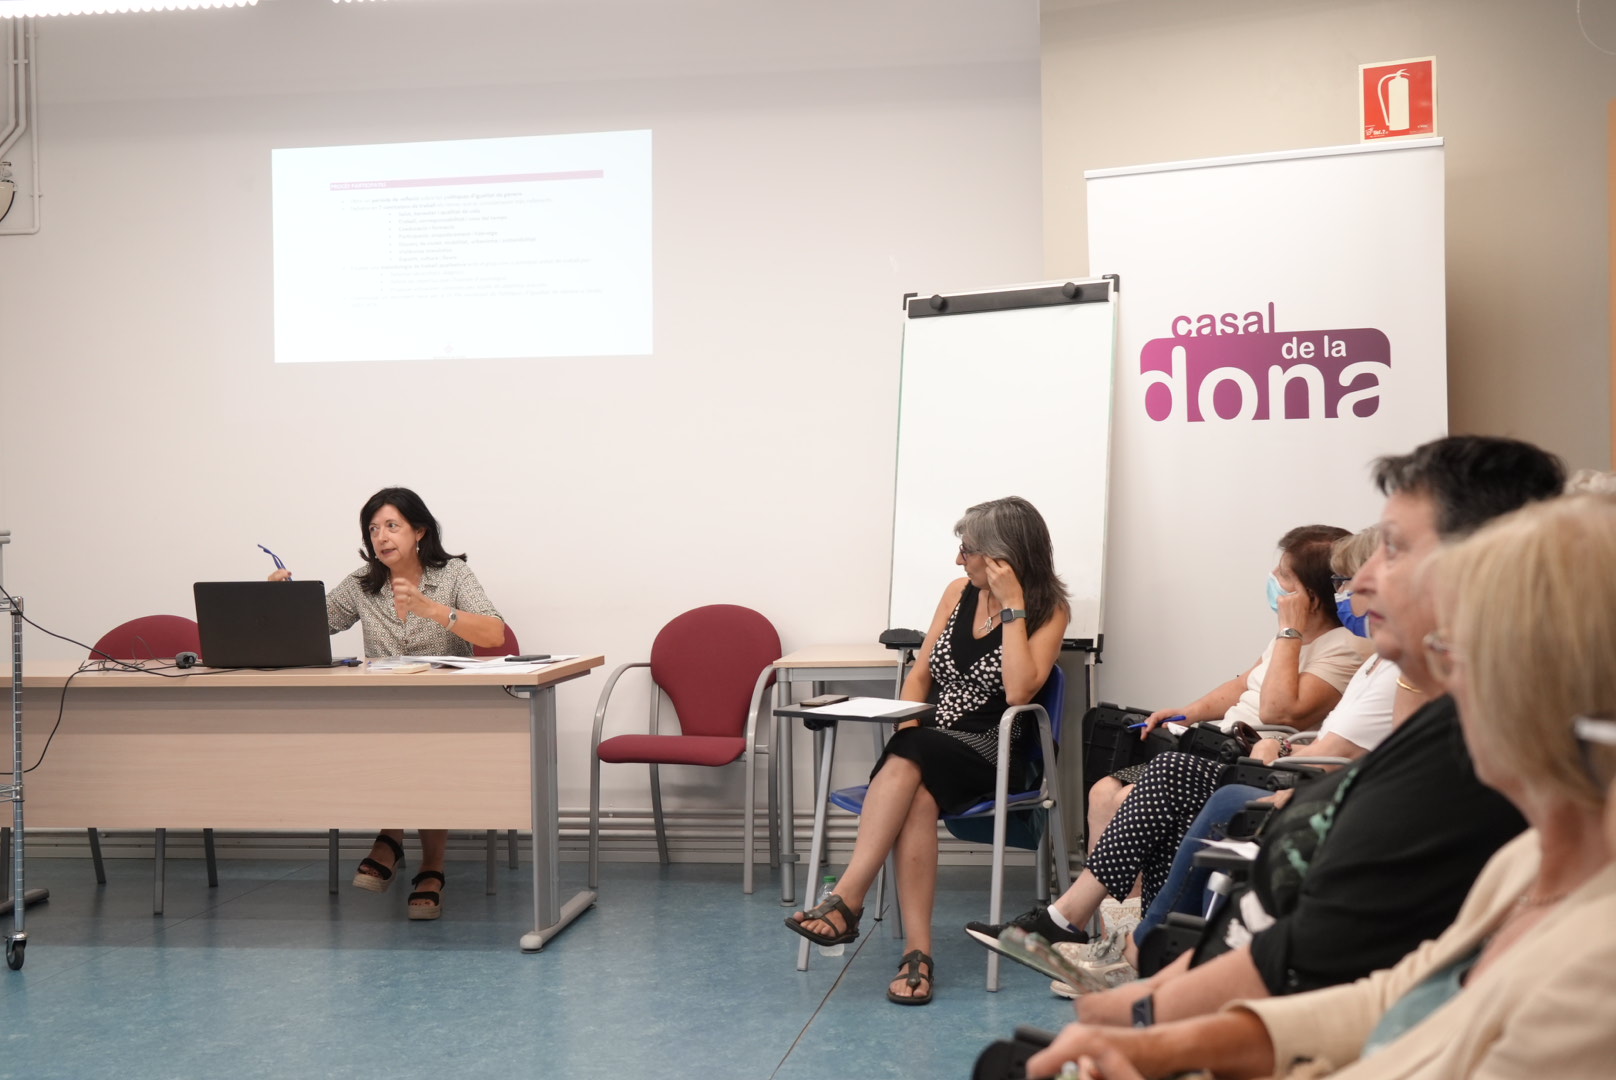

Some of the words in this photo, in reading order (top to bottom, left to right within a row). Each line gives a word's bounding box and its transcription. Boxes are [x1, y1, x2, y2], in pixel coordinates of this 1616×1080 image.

[1171, 301, 1275, 338] casal
[1281, 336, 1315, 359] de
[1323, 335, 1347, 358] la
[1139, 345, 1391, 422] dona
